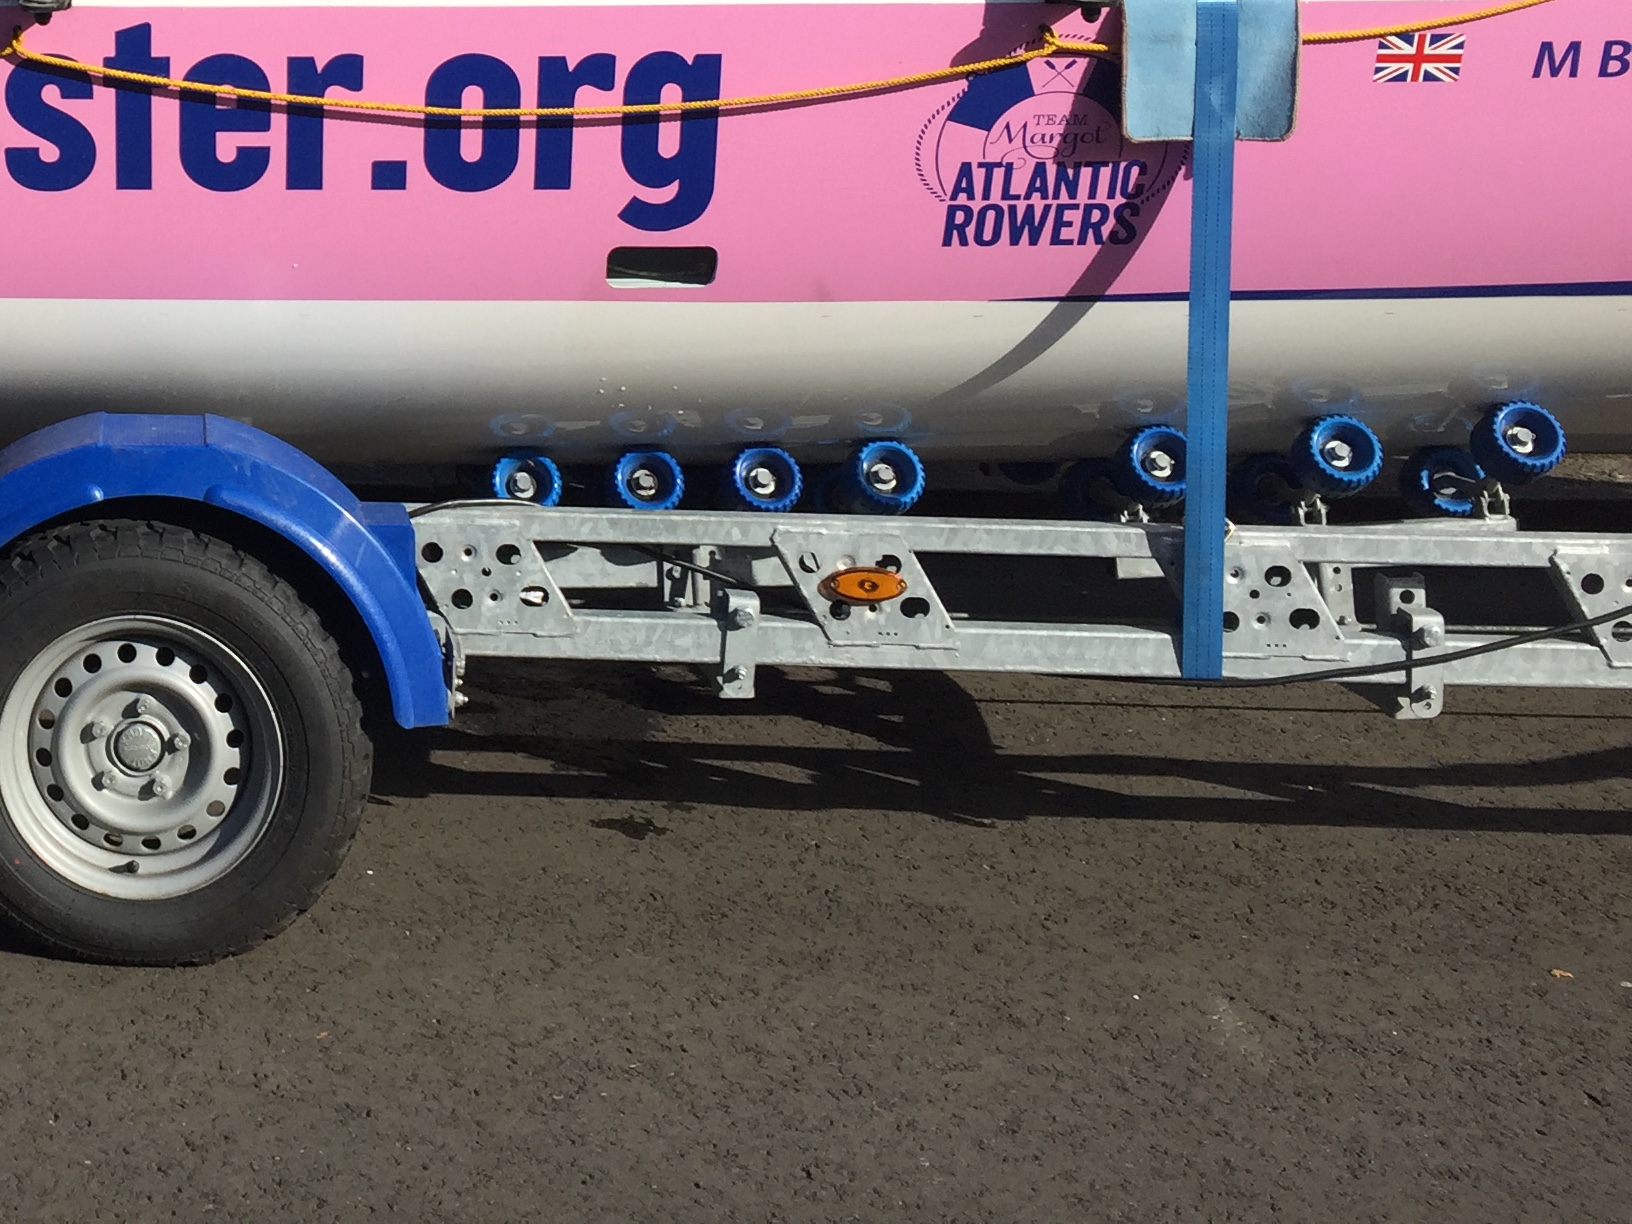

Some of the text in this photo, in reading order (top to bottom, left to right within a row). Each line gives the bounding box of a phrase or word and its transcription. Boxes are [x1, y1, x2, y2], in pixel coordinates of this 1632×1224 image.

[1531, 40, 1632, 78] M B
[1033, 114, 1088, 126] TEAM
[989, 120, 1111, 169] Margot
[948, 158, 1148, 202] ATLANTIC
[941, 201, 1142, 247] ROWERS
